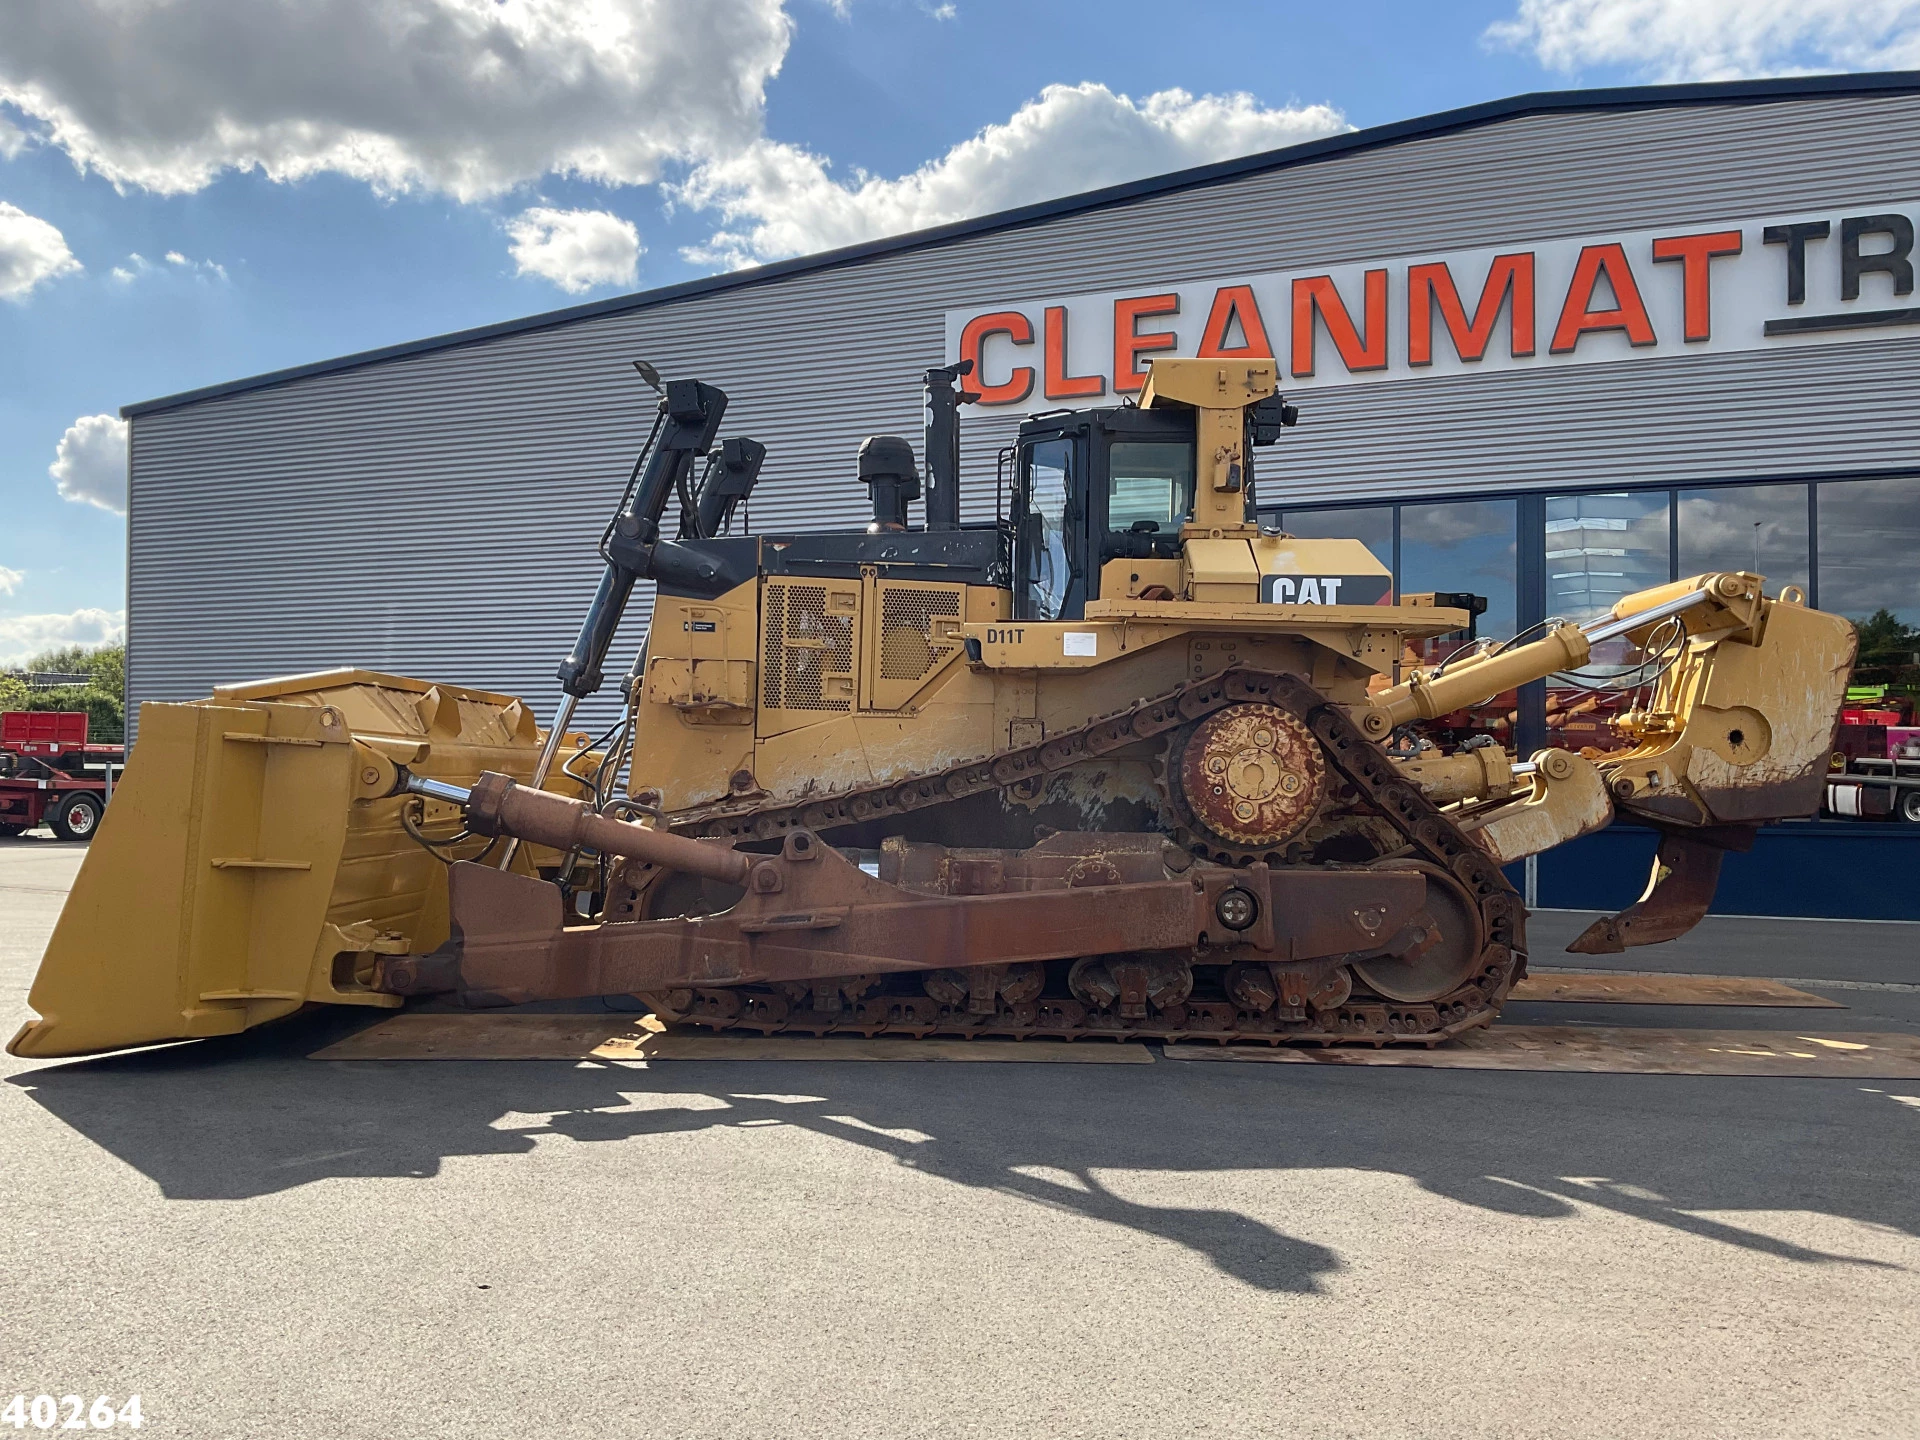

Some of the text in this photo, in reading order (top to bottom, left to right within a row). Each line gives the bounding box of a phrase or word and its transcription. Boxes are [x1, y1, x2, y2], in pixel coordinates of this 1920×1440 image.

[960, 213, 1914, 406] CLEANMAT TR
[1272, 577, 1342, 605] CAT
[987, 628, 1025, 644] D11T
